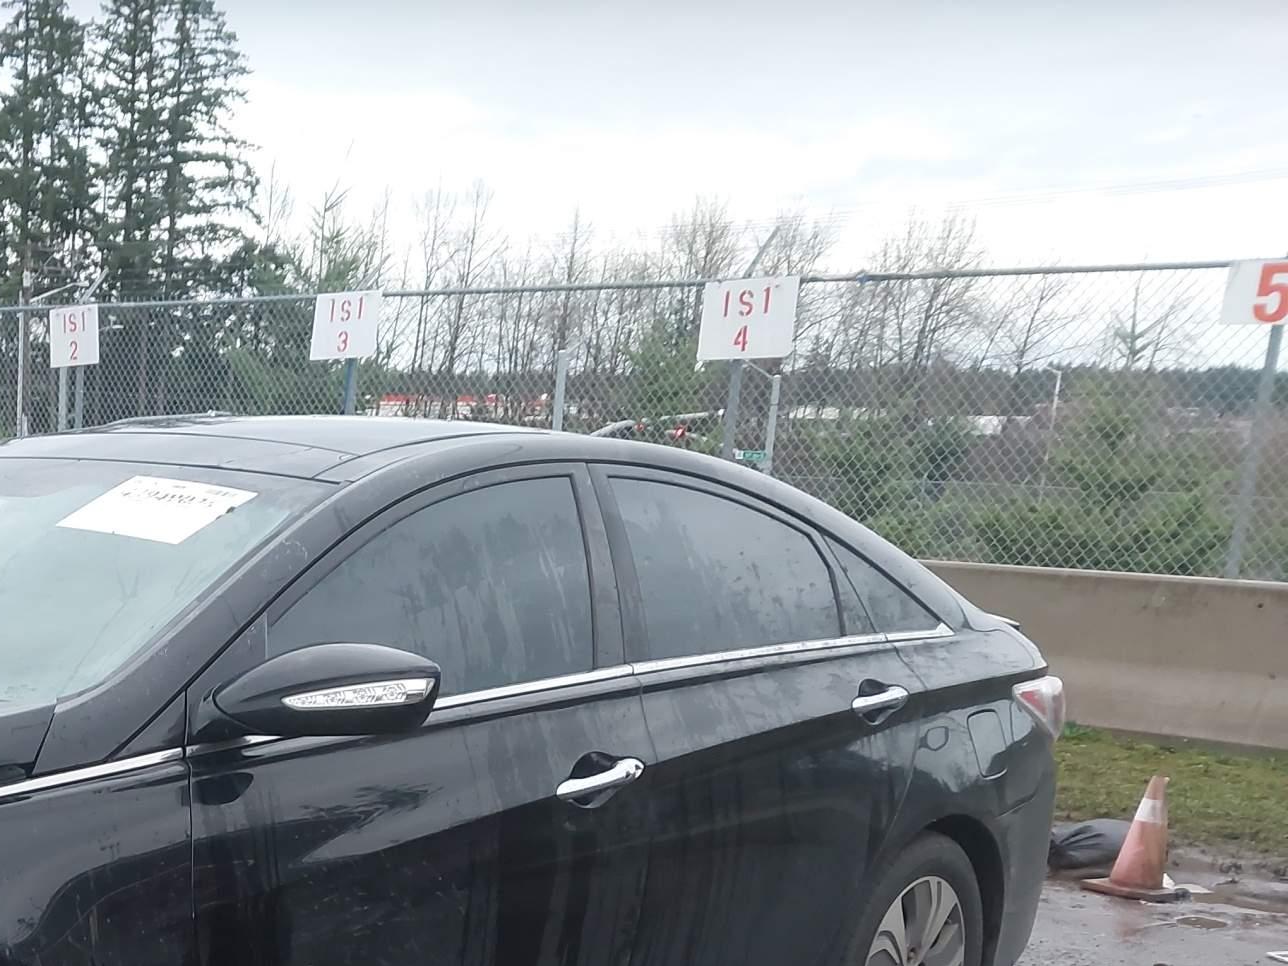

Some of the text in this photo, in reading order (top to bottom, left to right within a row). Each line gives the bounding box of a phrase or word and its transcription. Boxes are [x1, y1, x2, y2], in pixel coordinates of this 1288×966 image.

[337, 331, 348, 353] 3
[733, 325, 748, 352] 4
[69, 340, 78, 361] 2
